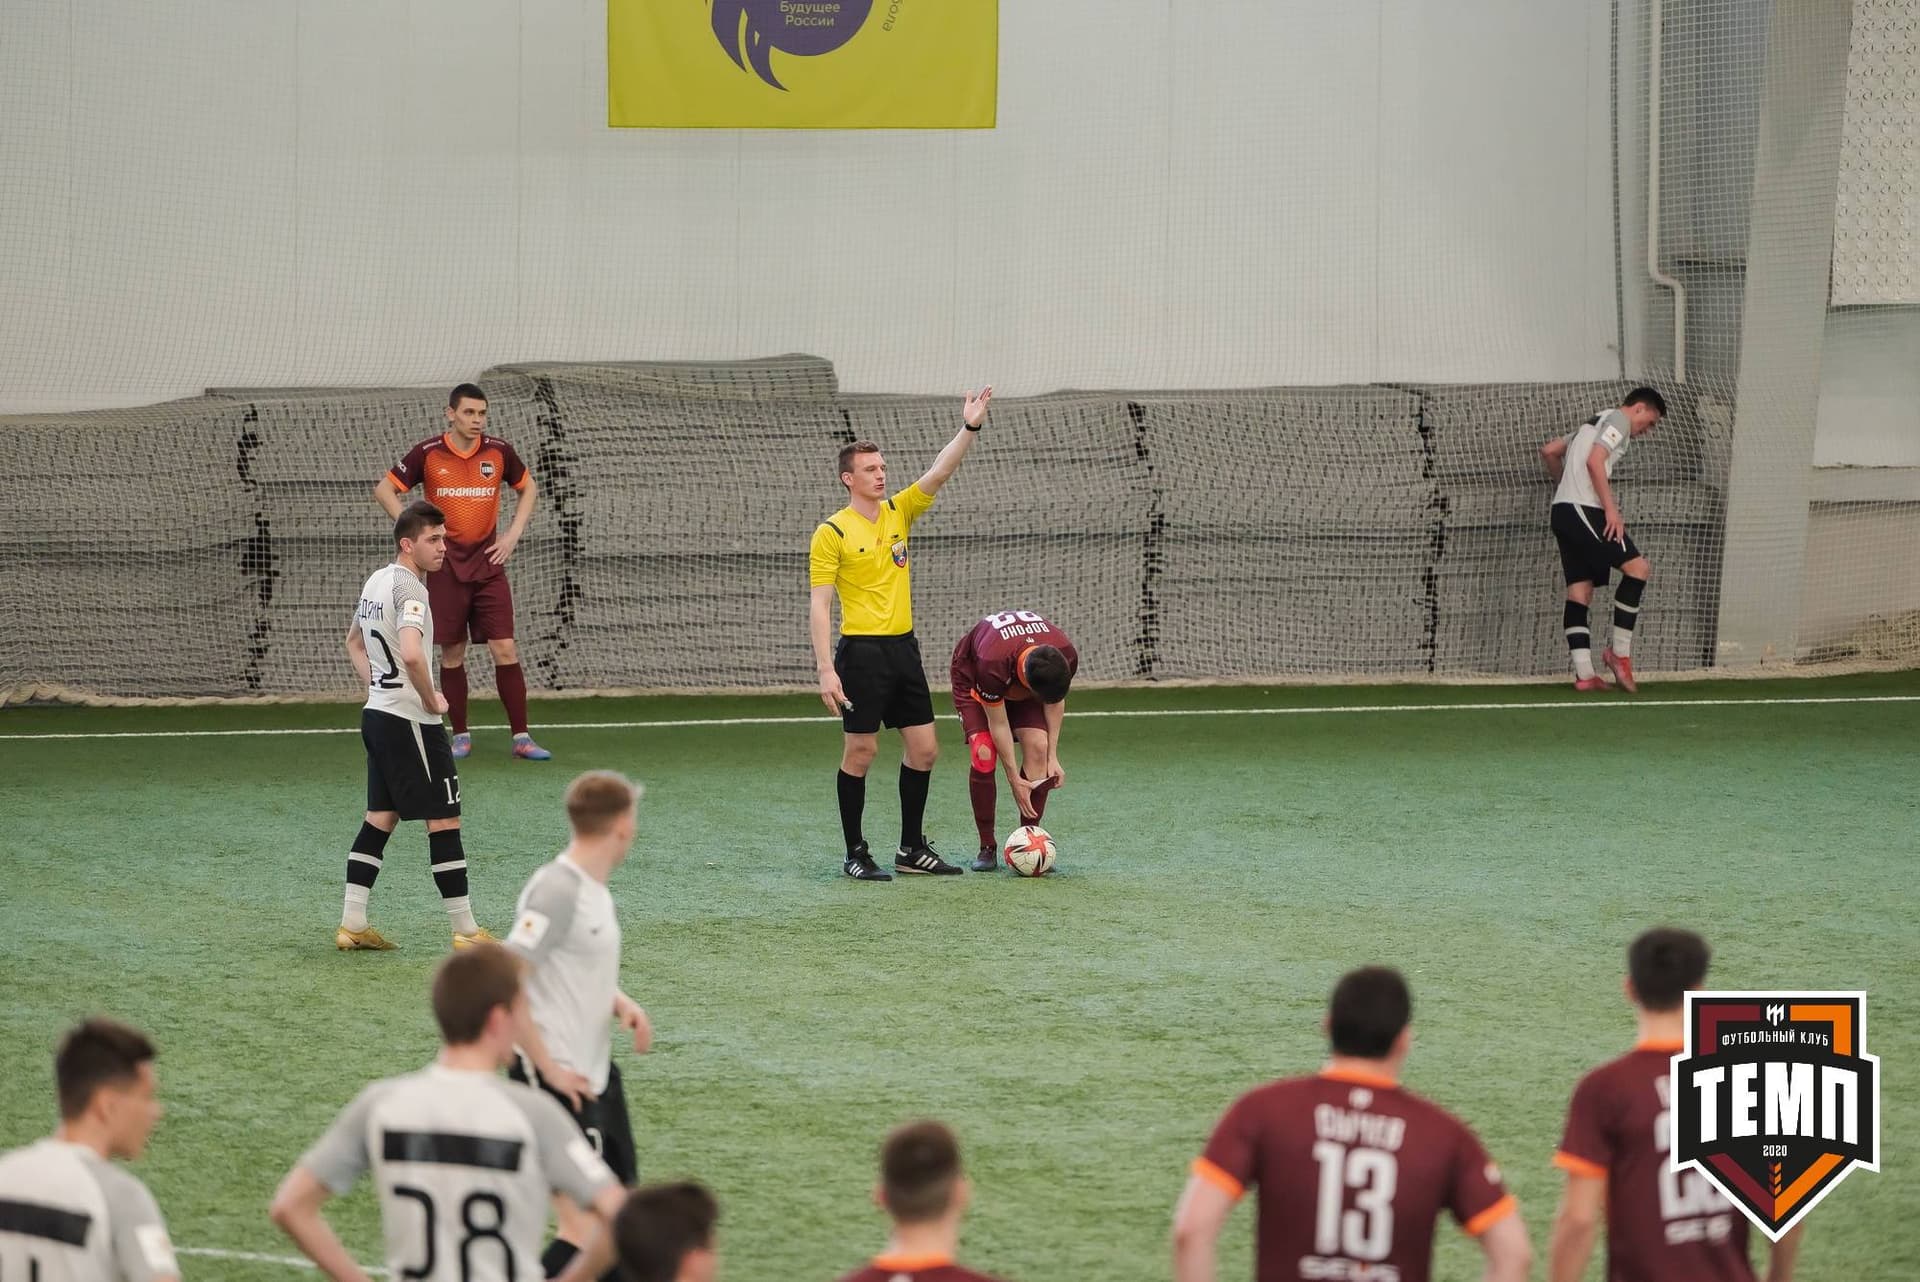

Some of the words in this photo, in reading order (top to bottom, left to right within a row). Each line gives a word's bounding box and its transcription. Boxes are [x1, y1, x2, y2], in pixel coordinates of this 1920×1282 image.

[780, 1, 841, 15] Будущее
[785, 14, 835, 27] России
[436, 486, 497, 497] ПРОДИНВЕСТ
[999, 622, 1050, 640] ВОРОНА
[1311, 1139, 1399, 1262] 13
